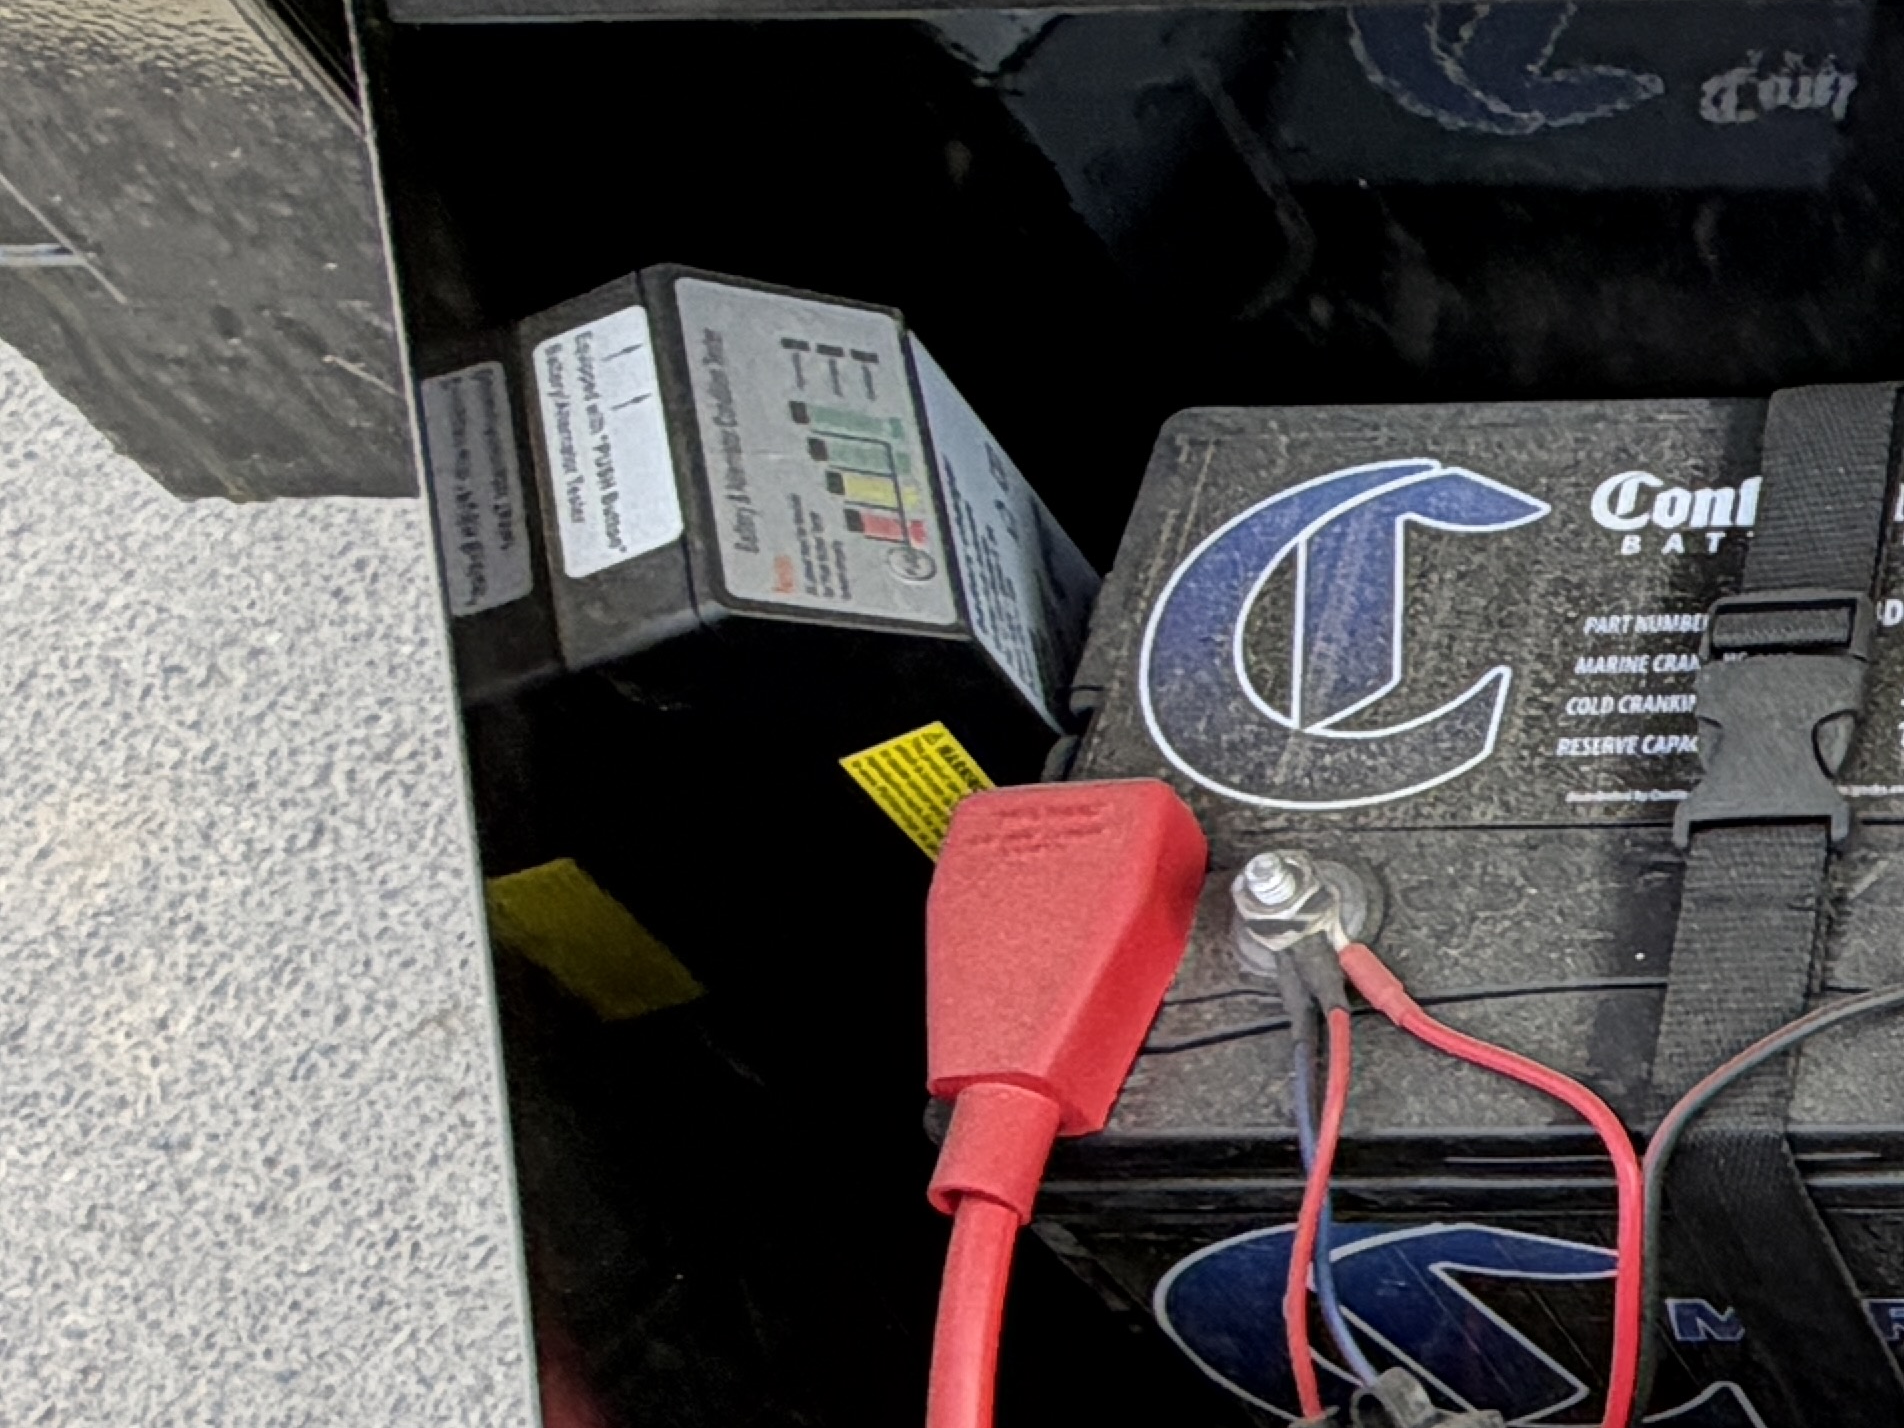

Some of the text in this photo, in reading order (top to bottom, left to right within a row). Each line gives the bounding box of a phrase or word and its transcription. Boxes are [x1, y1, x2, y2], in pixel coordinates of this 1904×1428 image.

[1584, 617, 1632, 636] PART
[1636, 613, 1708, 635] NUMBE
[1575, 655, 1650, 676] MARINE
[1565, 698, 1615, 717] COLD
[1618, 695, 1696, 716] CRANKI
[1556, 737, 1636, 757] RESERVE
[1641, 735, 1698, 755] CAPAC
